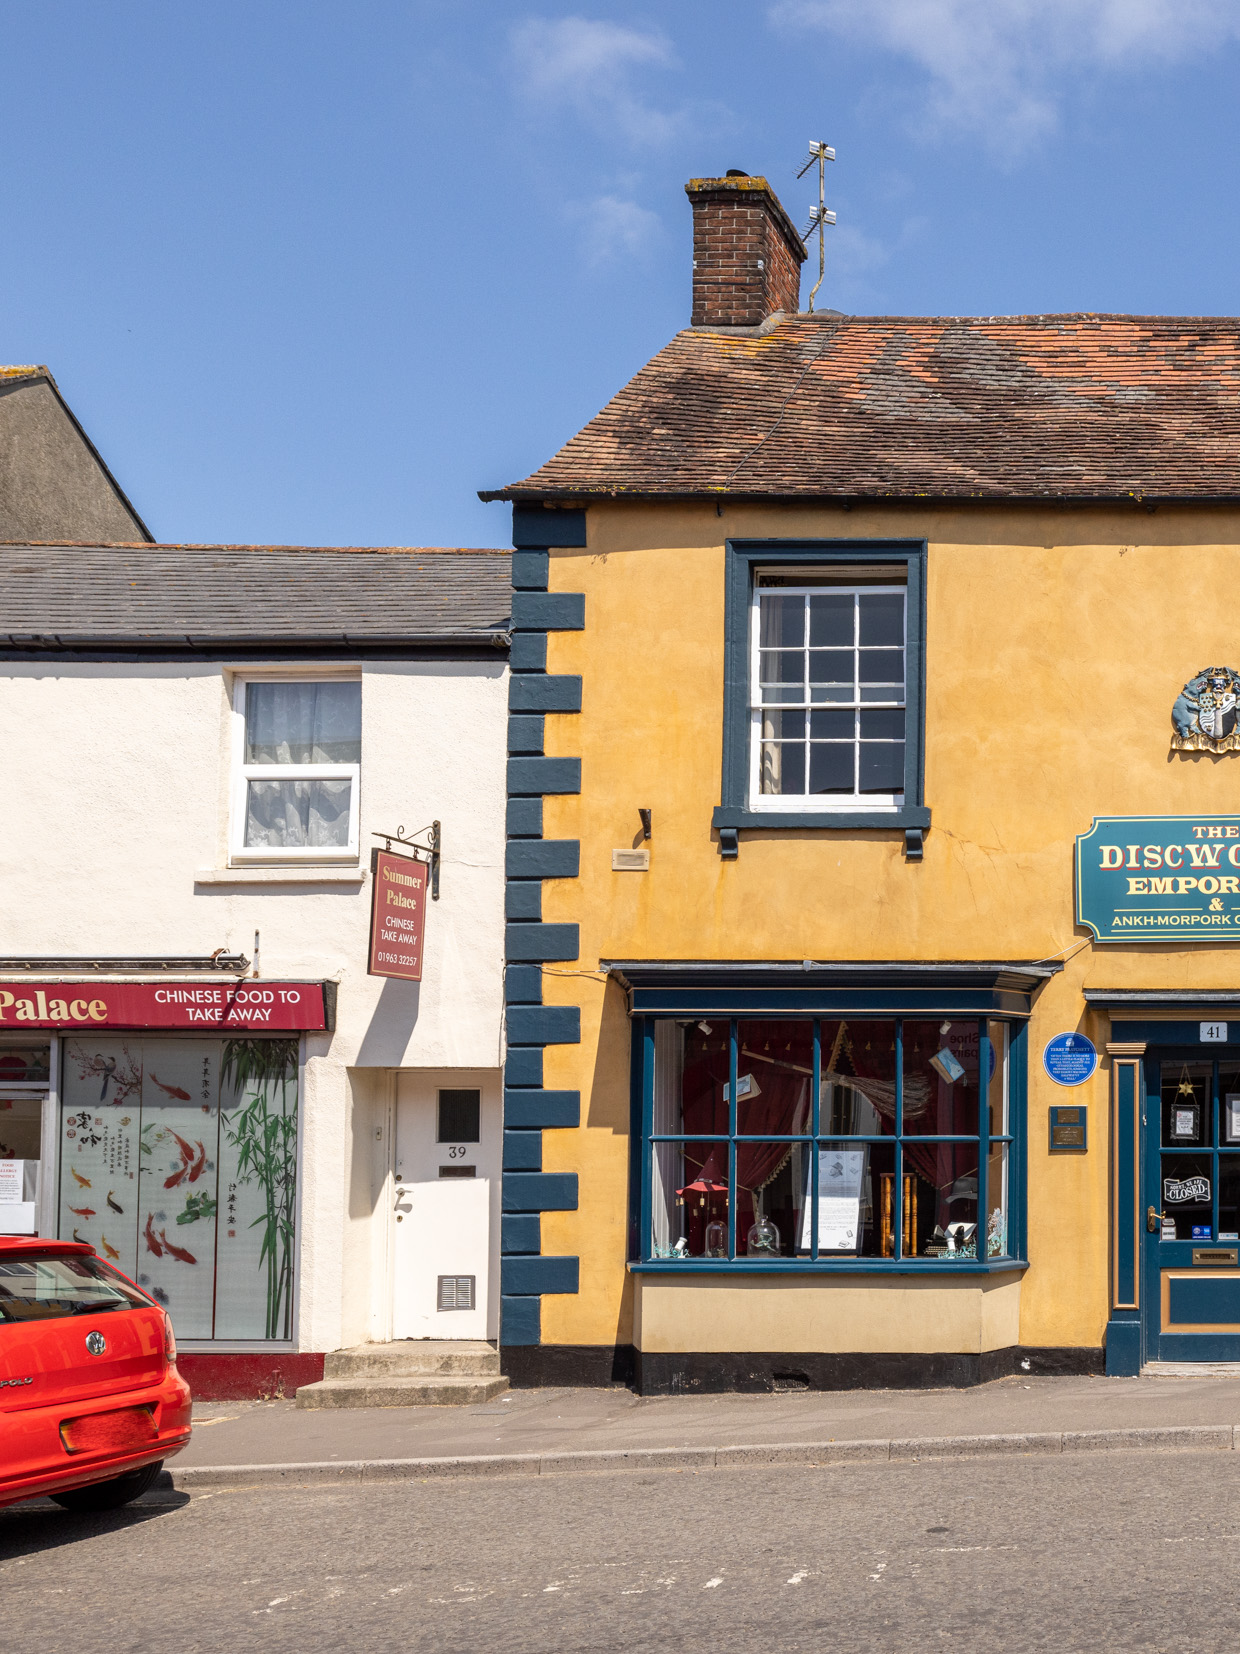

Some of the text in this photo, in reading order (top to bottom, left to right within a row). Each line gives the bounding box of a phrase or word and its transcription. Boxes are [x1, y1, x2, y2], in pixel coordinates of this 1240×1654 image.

[1192, 825, 1240, 839] THE
[382, 865, 422, 889] Summer
[386, 889, 417, 910] Palace
[1208, 897, 1225, 911] &
[385, 916, 415, 931] CHINESE
[1112, 915, 1232, 927] ANKH-MORPORK
[381, 929, 418, 946] TAKE AWAY
[378, 951, 418, 967] 01963 32257
[154, 990, 301, 1004] CHINESE FOOD TO
[0, 990, 108, 1021] Palace
[186, 1008, 272, 1021] TAKE AWAY
[1206, 1026, 1220, 1039] 41
[448, 1146, 467, 1159] 39
[1169, 1184, 1205, 1200] CLOSED
[0, 1377, 33, 1388] POLO
